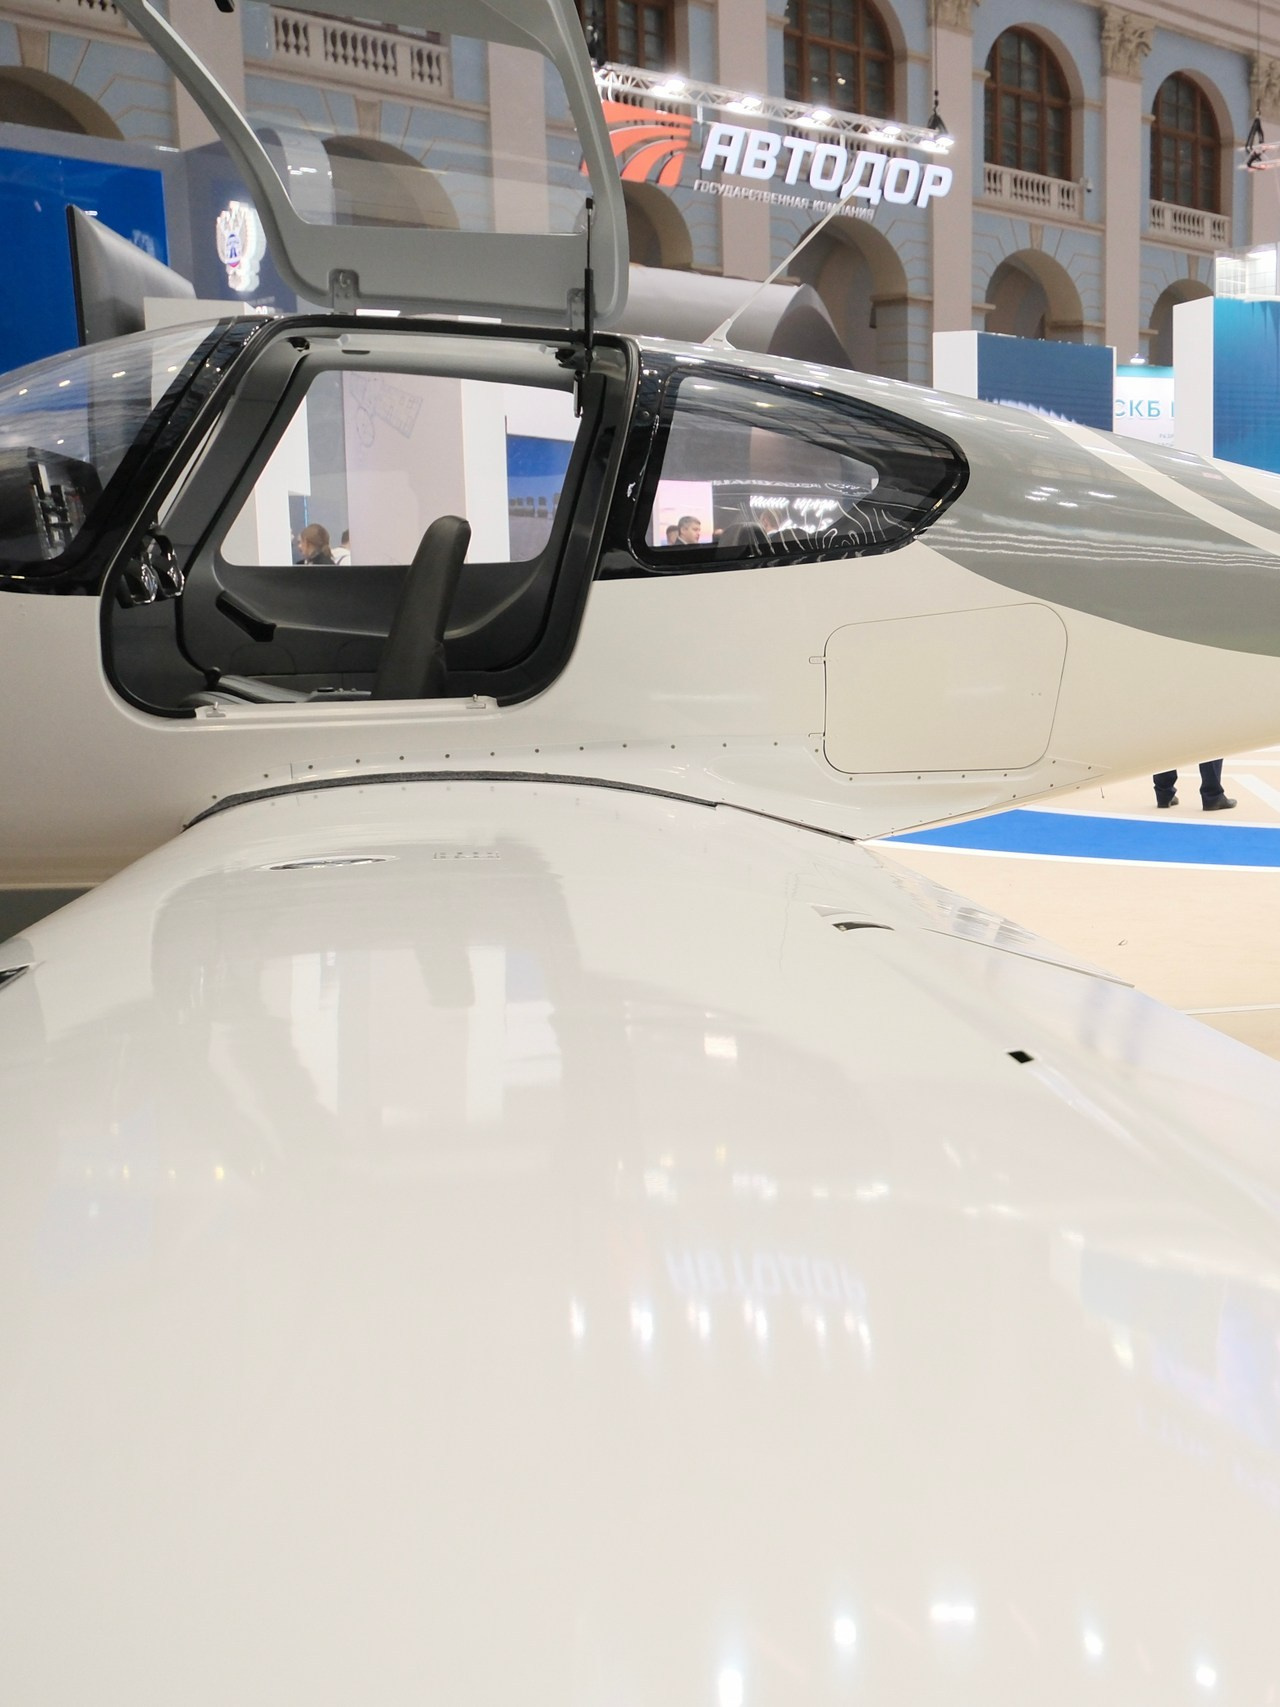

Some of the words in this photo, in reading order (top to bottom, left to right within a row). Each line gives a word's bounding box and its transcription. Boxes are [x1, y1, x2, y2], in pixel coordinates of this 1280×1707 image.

[700, 122, 953, 208] АВТОДОР
[693, 179, 809, 208] ГОСУДАРСТВЕННАЯ
[1115, 399, 1161, 417] СКБ
